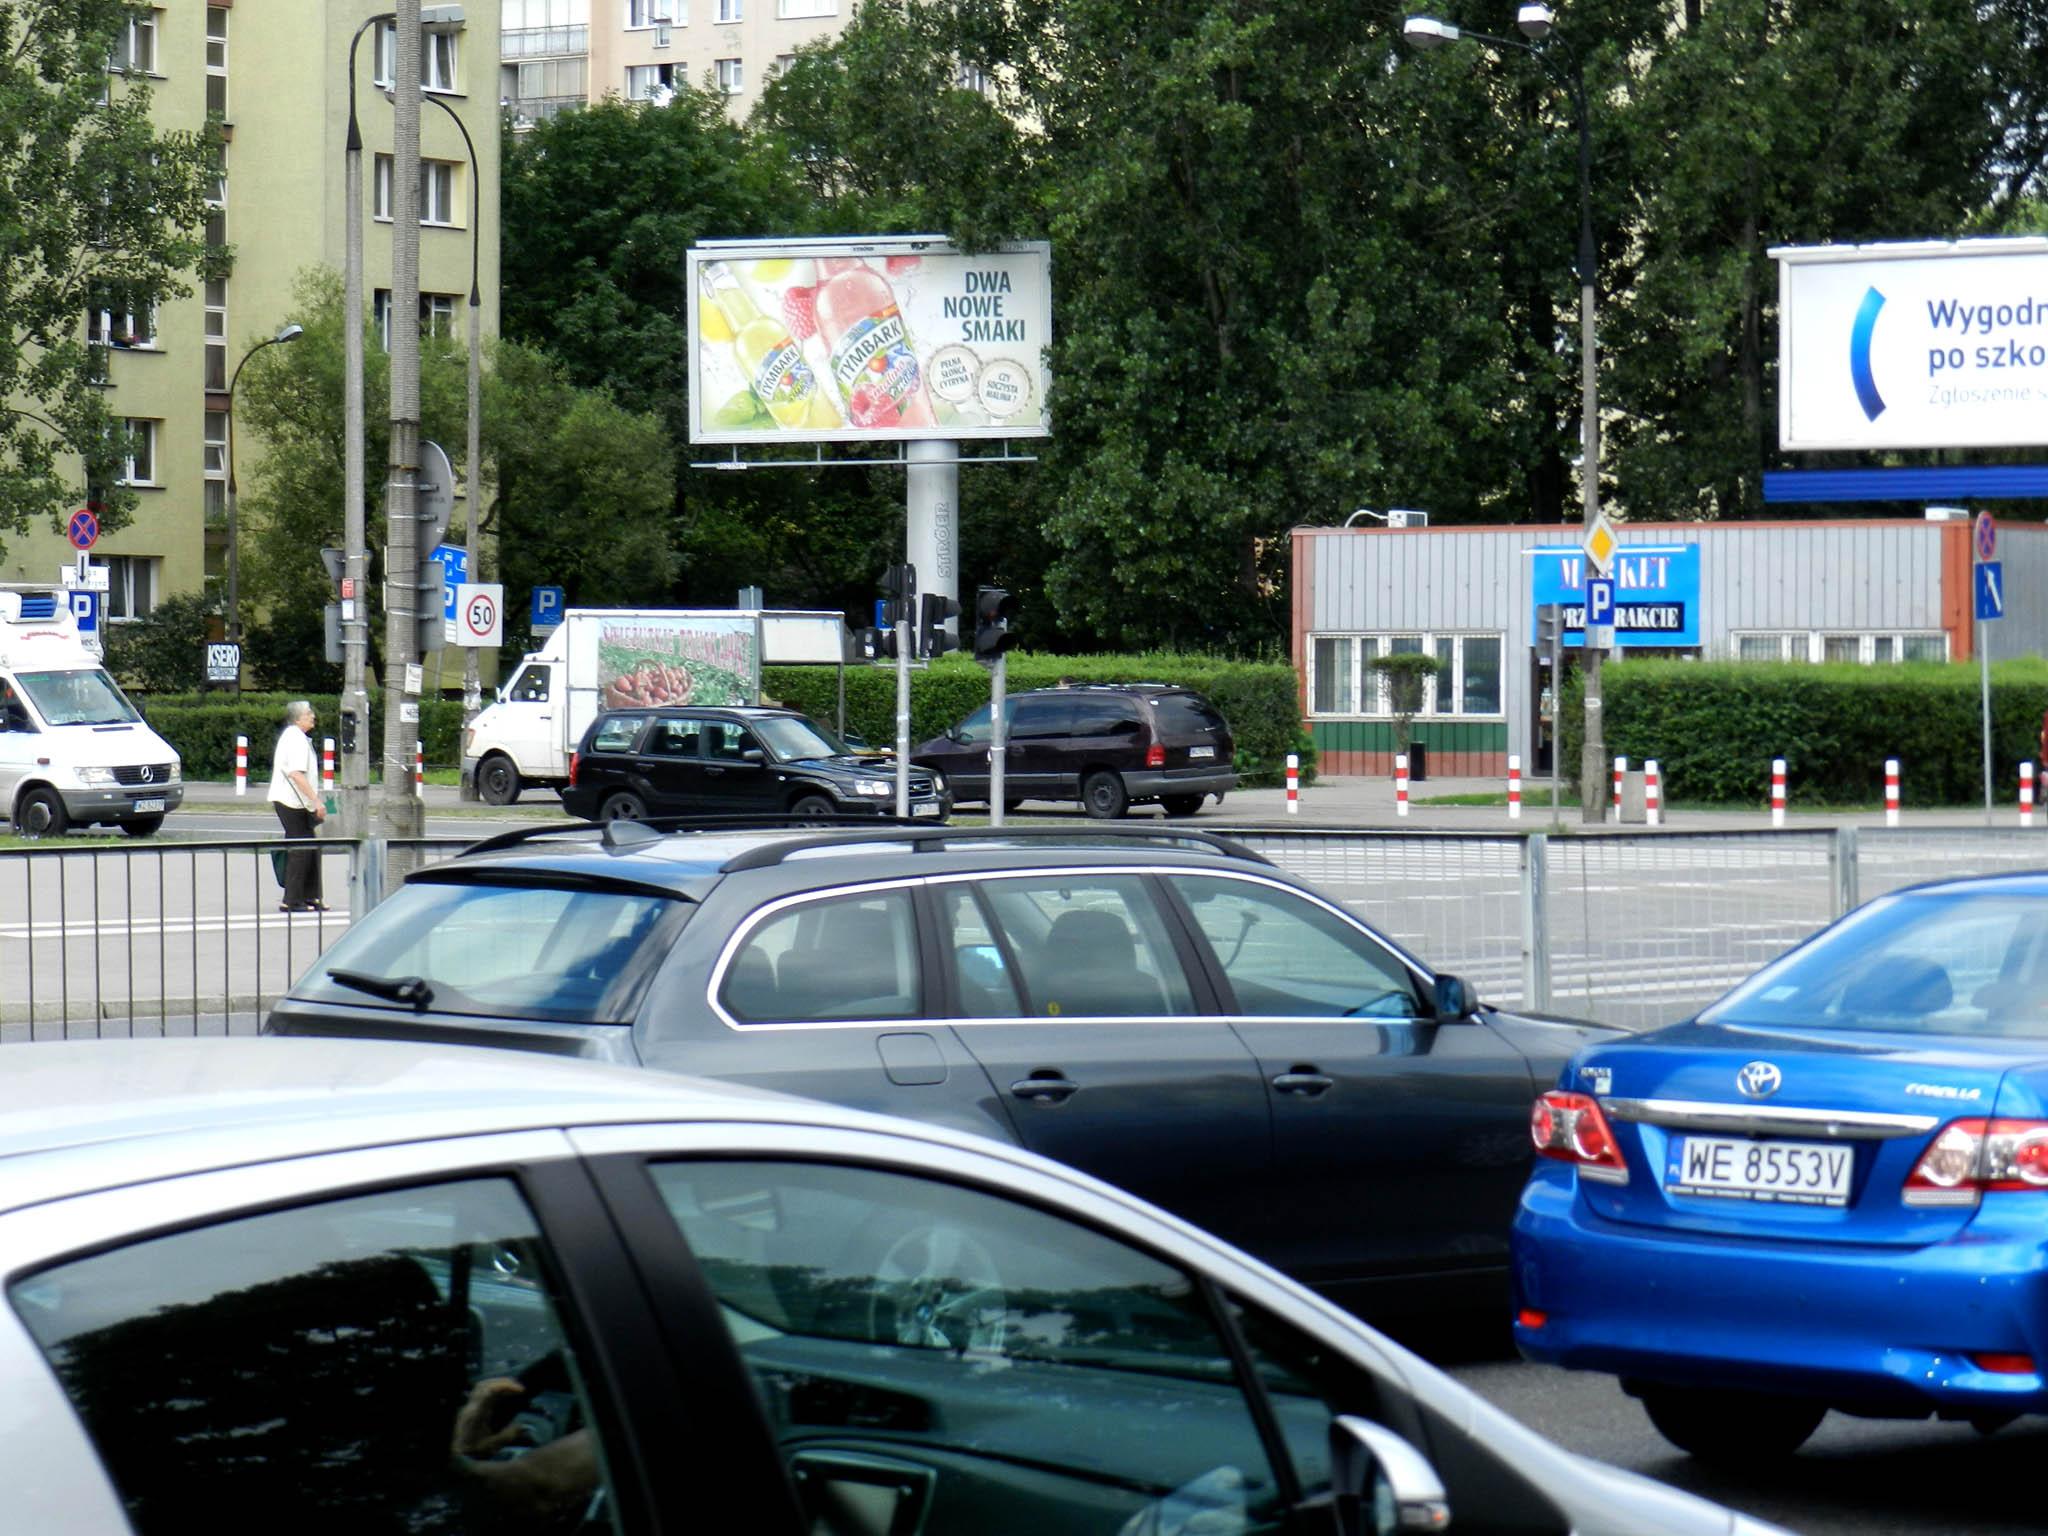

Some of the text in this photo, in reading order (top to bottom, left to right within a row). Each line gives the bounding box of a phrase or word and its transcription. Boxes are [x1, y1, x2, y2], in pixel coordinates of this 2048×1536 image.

[965, 271, 1011, 293] DWA
[944, 296, 1004, 318] NOWE
[962, 320, 1025, 342] SMAKI
[839, 319, 901, 384] TYMBARK
[1929, 347, 1965, 378] po
[761, 347, 798, 397] TYMBARK
[1593, 583, 1610, 620] P
[472, 606, 493, 625] 50
[1614, 606, 1679, 629] RAKCIE
[208, 644, 240, 668] KSERO
[1689, 1143, 1849, 1190] WE 8553V
